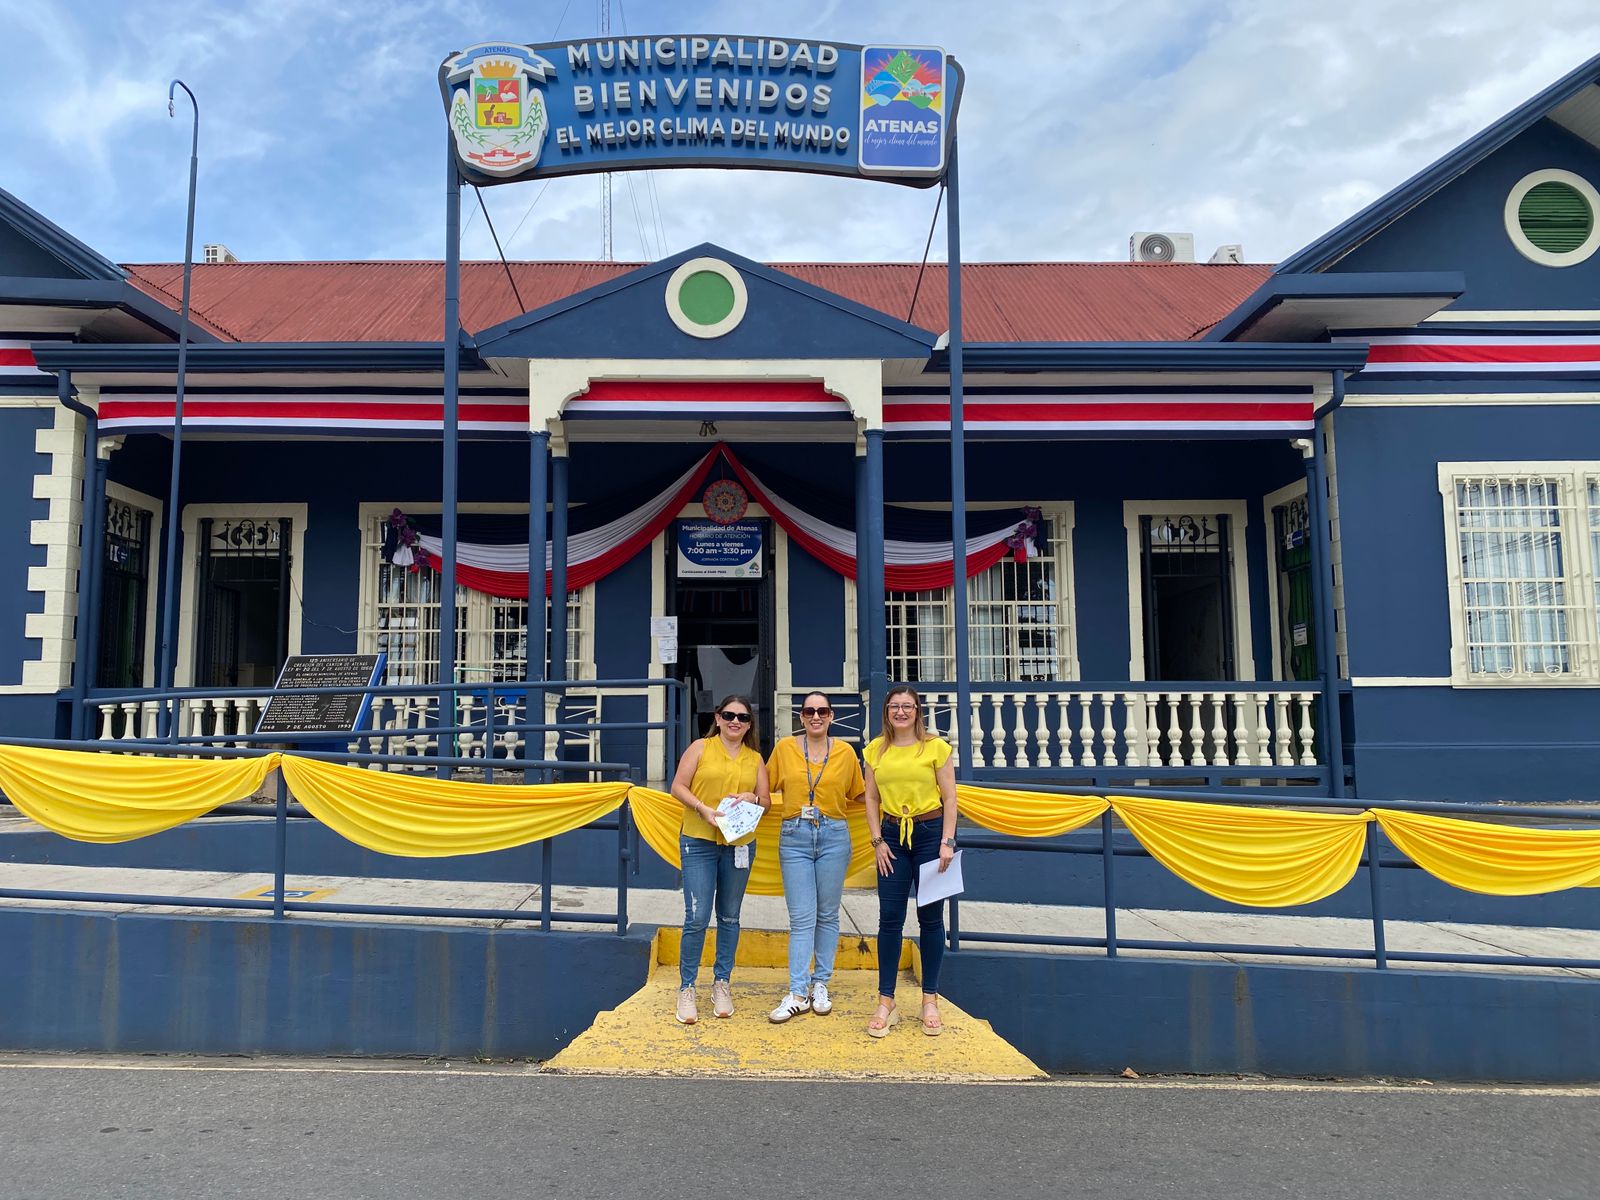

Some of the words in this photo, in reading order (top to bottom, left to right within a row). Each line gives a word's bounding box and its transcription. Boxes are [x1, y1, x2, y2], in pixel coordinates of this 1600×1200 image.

[567, 37, 839, 71] MUNICIPALIDAD
[574, 78, 832, 110] BIENVENIDOS
[556, 126, 581, 147] EL
[586, 118, 655, 143] MEJOR
[659, 117, 725, 140] CLIMA
[731, 118, 769, 142] DEL
[775, 121, 850, 148] MUNDO
[864, 119, 939, 134] ATENAS
